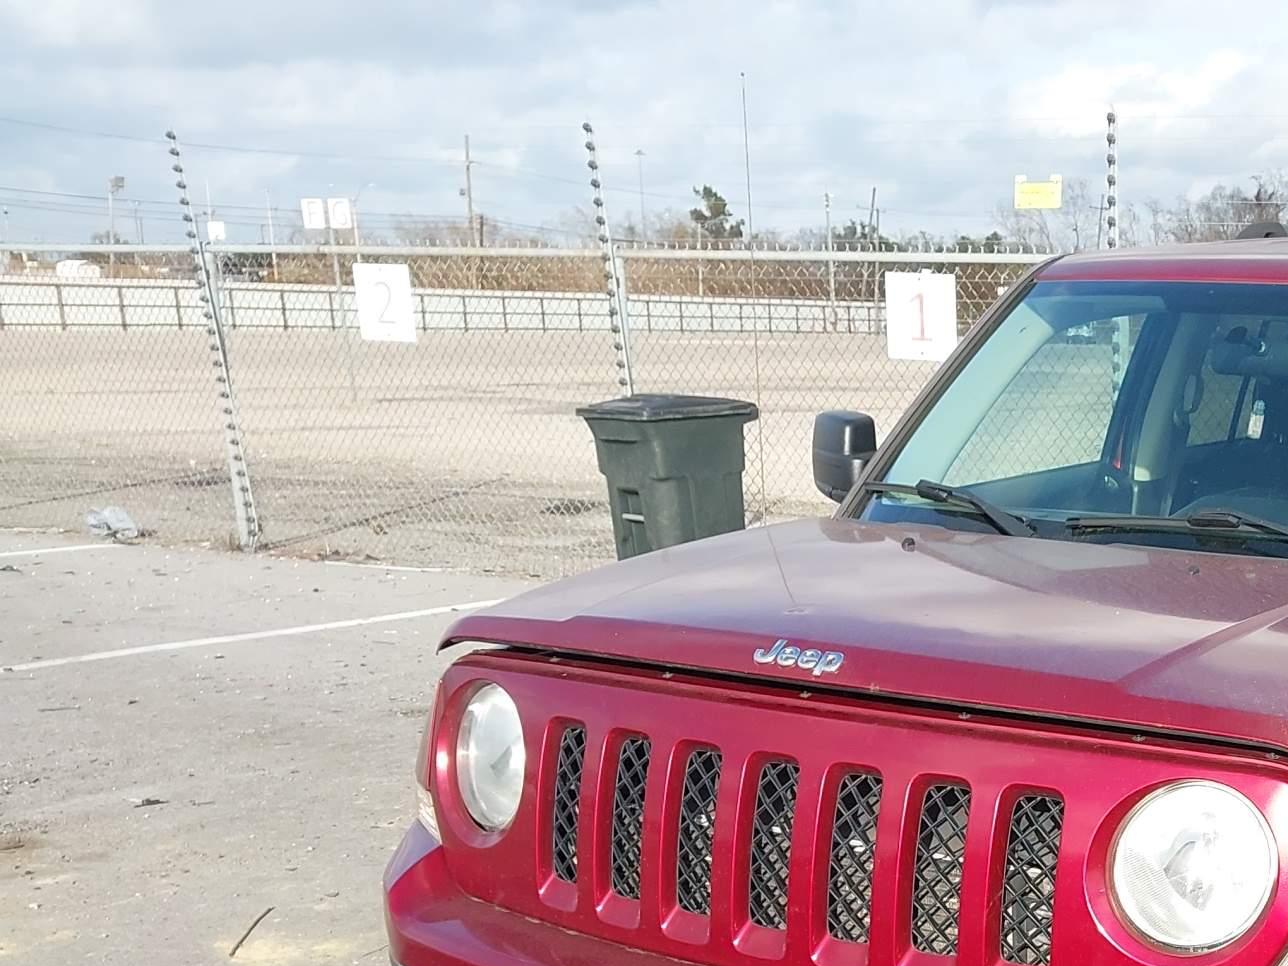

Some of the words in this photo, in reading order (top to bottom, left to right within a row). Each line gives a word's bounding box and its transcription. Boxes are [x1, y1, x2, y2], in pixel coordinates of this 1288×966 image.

[374, 281, 397, 324] 2
[909, 292, 933, 341] 1
[752, 638, 845, 677] Jeep
